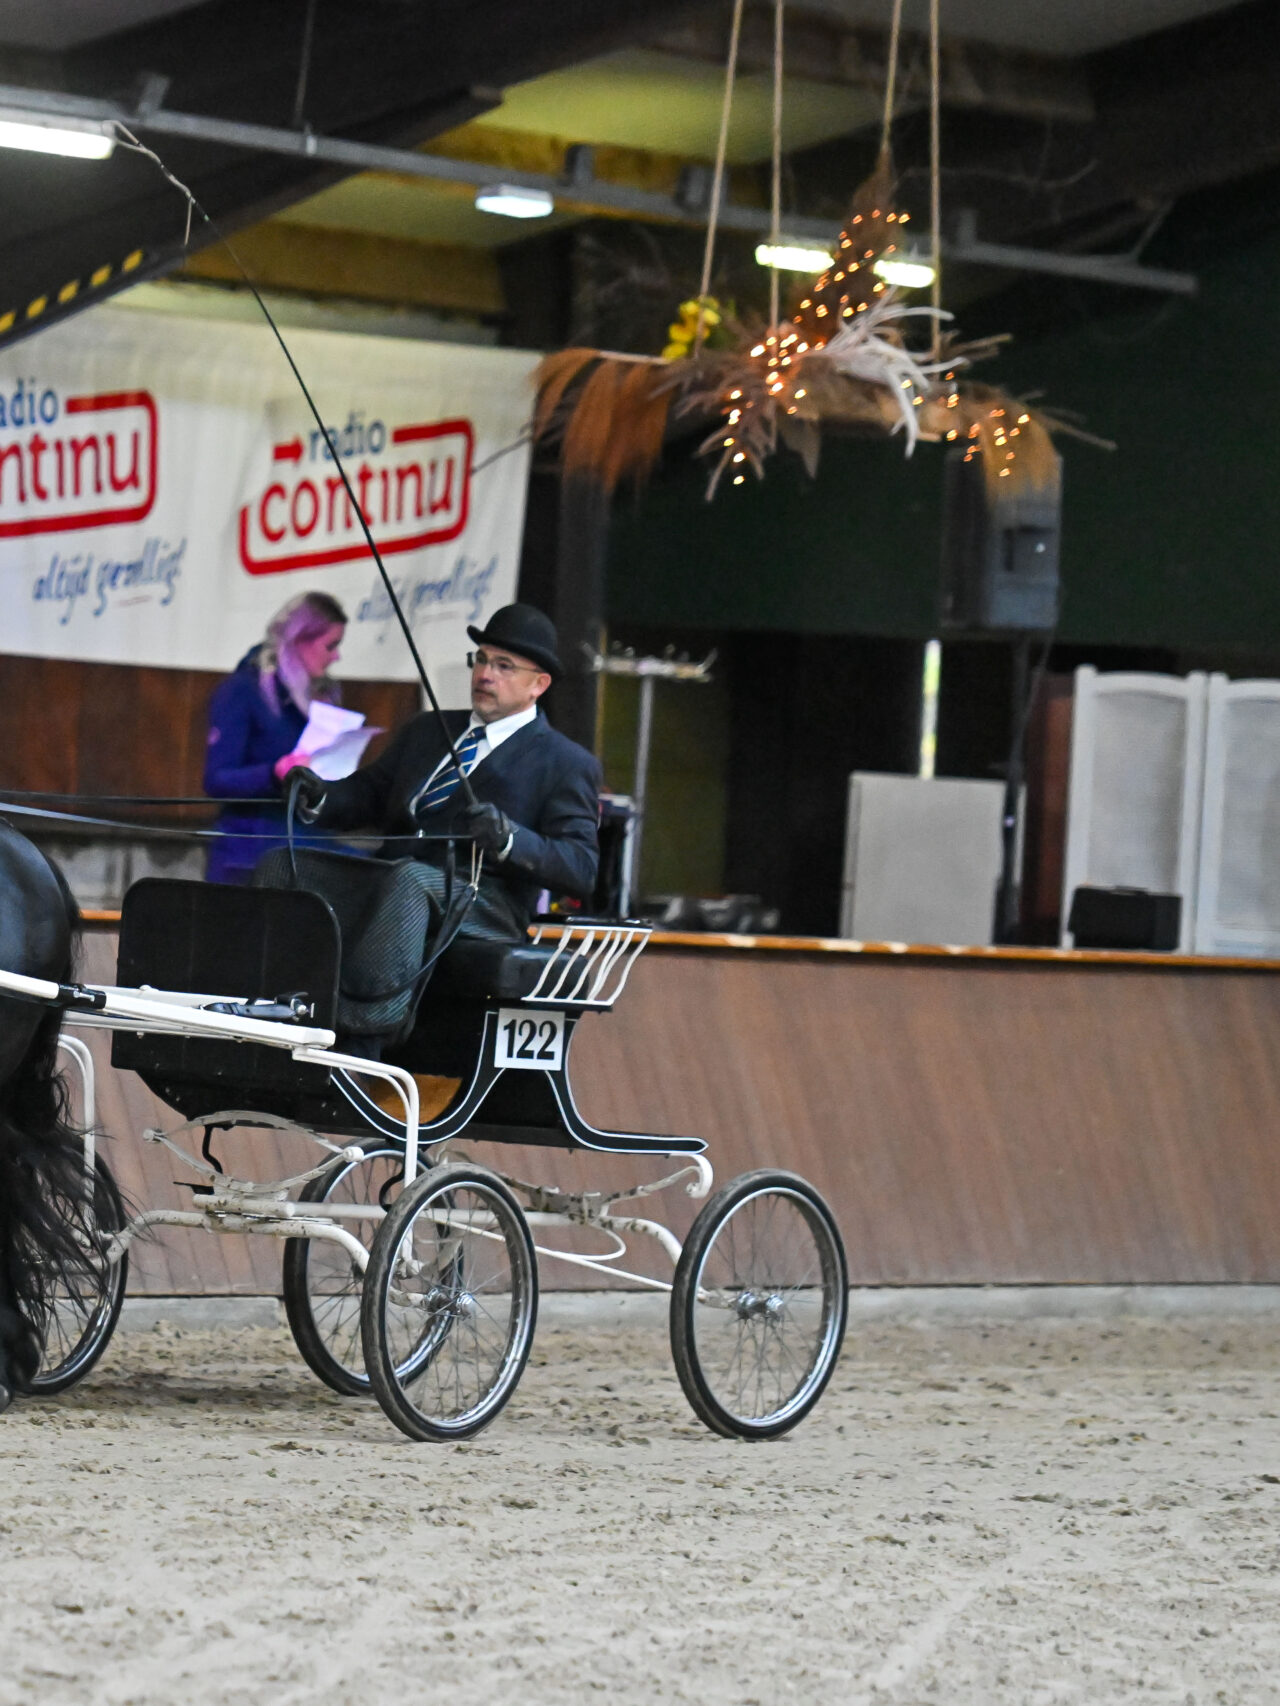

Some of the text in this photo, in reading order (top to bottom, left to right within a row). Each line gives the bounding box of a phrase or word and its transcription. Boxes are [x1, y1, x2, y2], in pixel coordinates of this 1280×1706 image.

[309, 409, 387, 461] radio
[259, 456, 456, 542] continu
[503, 1019, 558, 1060] 122
